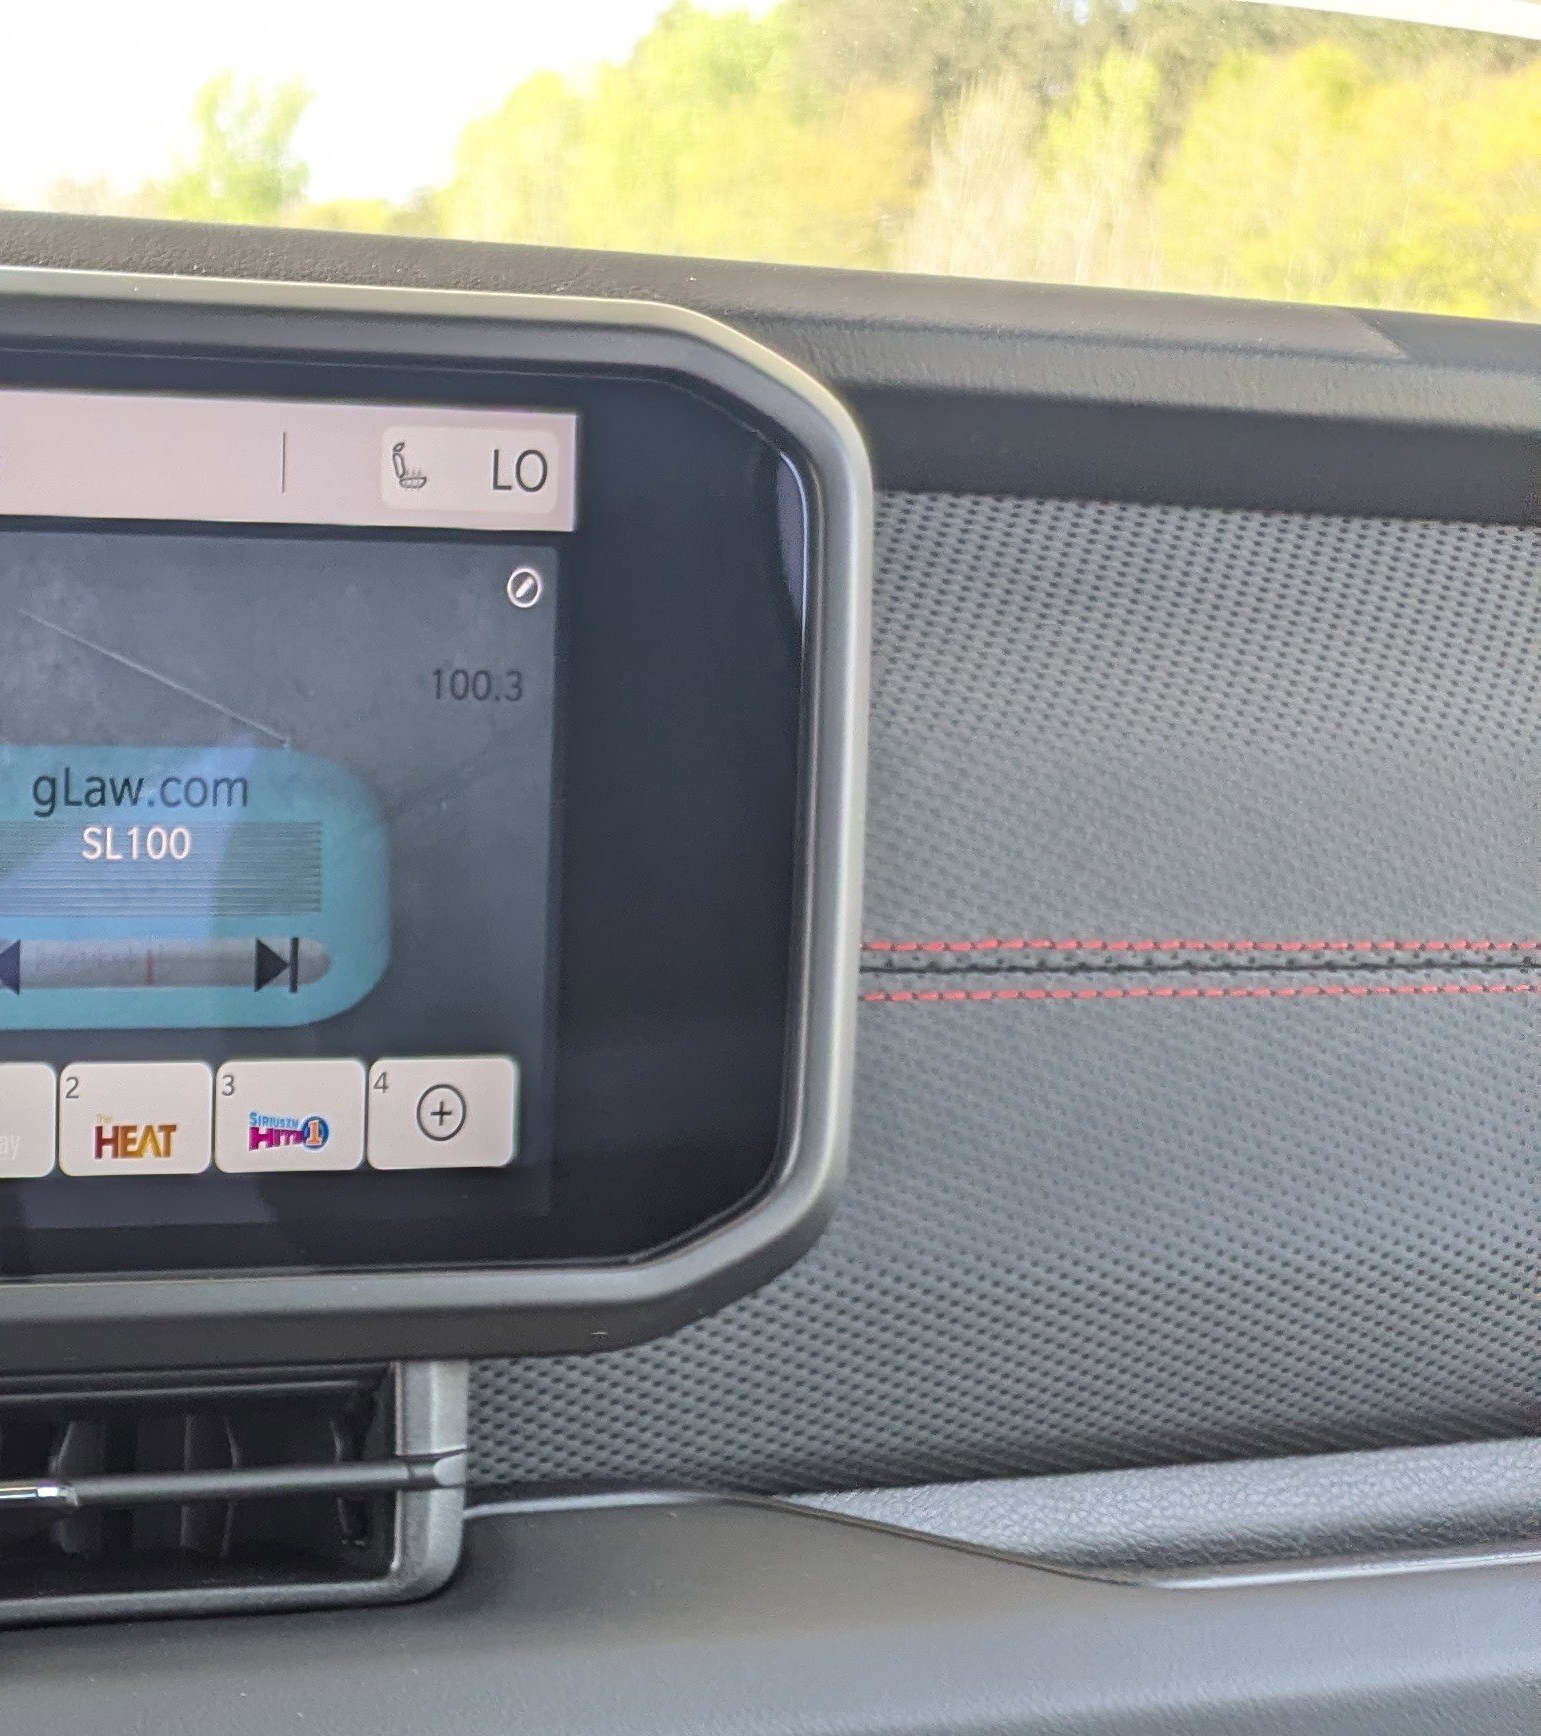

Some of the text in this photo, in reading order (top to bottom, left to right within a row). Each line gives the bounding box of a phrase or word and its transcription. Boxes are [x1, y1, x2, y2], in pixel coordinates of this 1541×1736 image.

[492, 449, 549, 493] LO
[430, 669, 524, 704] 100.3
[33, 769, 250, 818] gLaw.com
[81, 826, 192, 863] SL100
[64, 1076, 80, 1100] 2
[220, 1073, 236, 1097] 3
[373, 1071, 390, 1094] 4
[95, 1125, 177, 1160] HEAT
